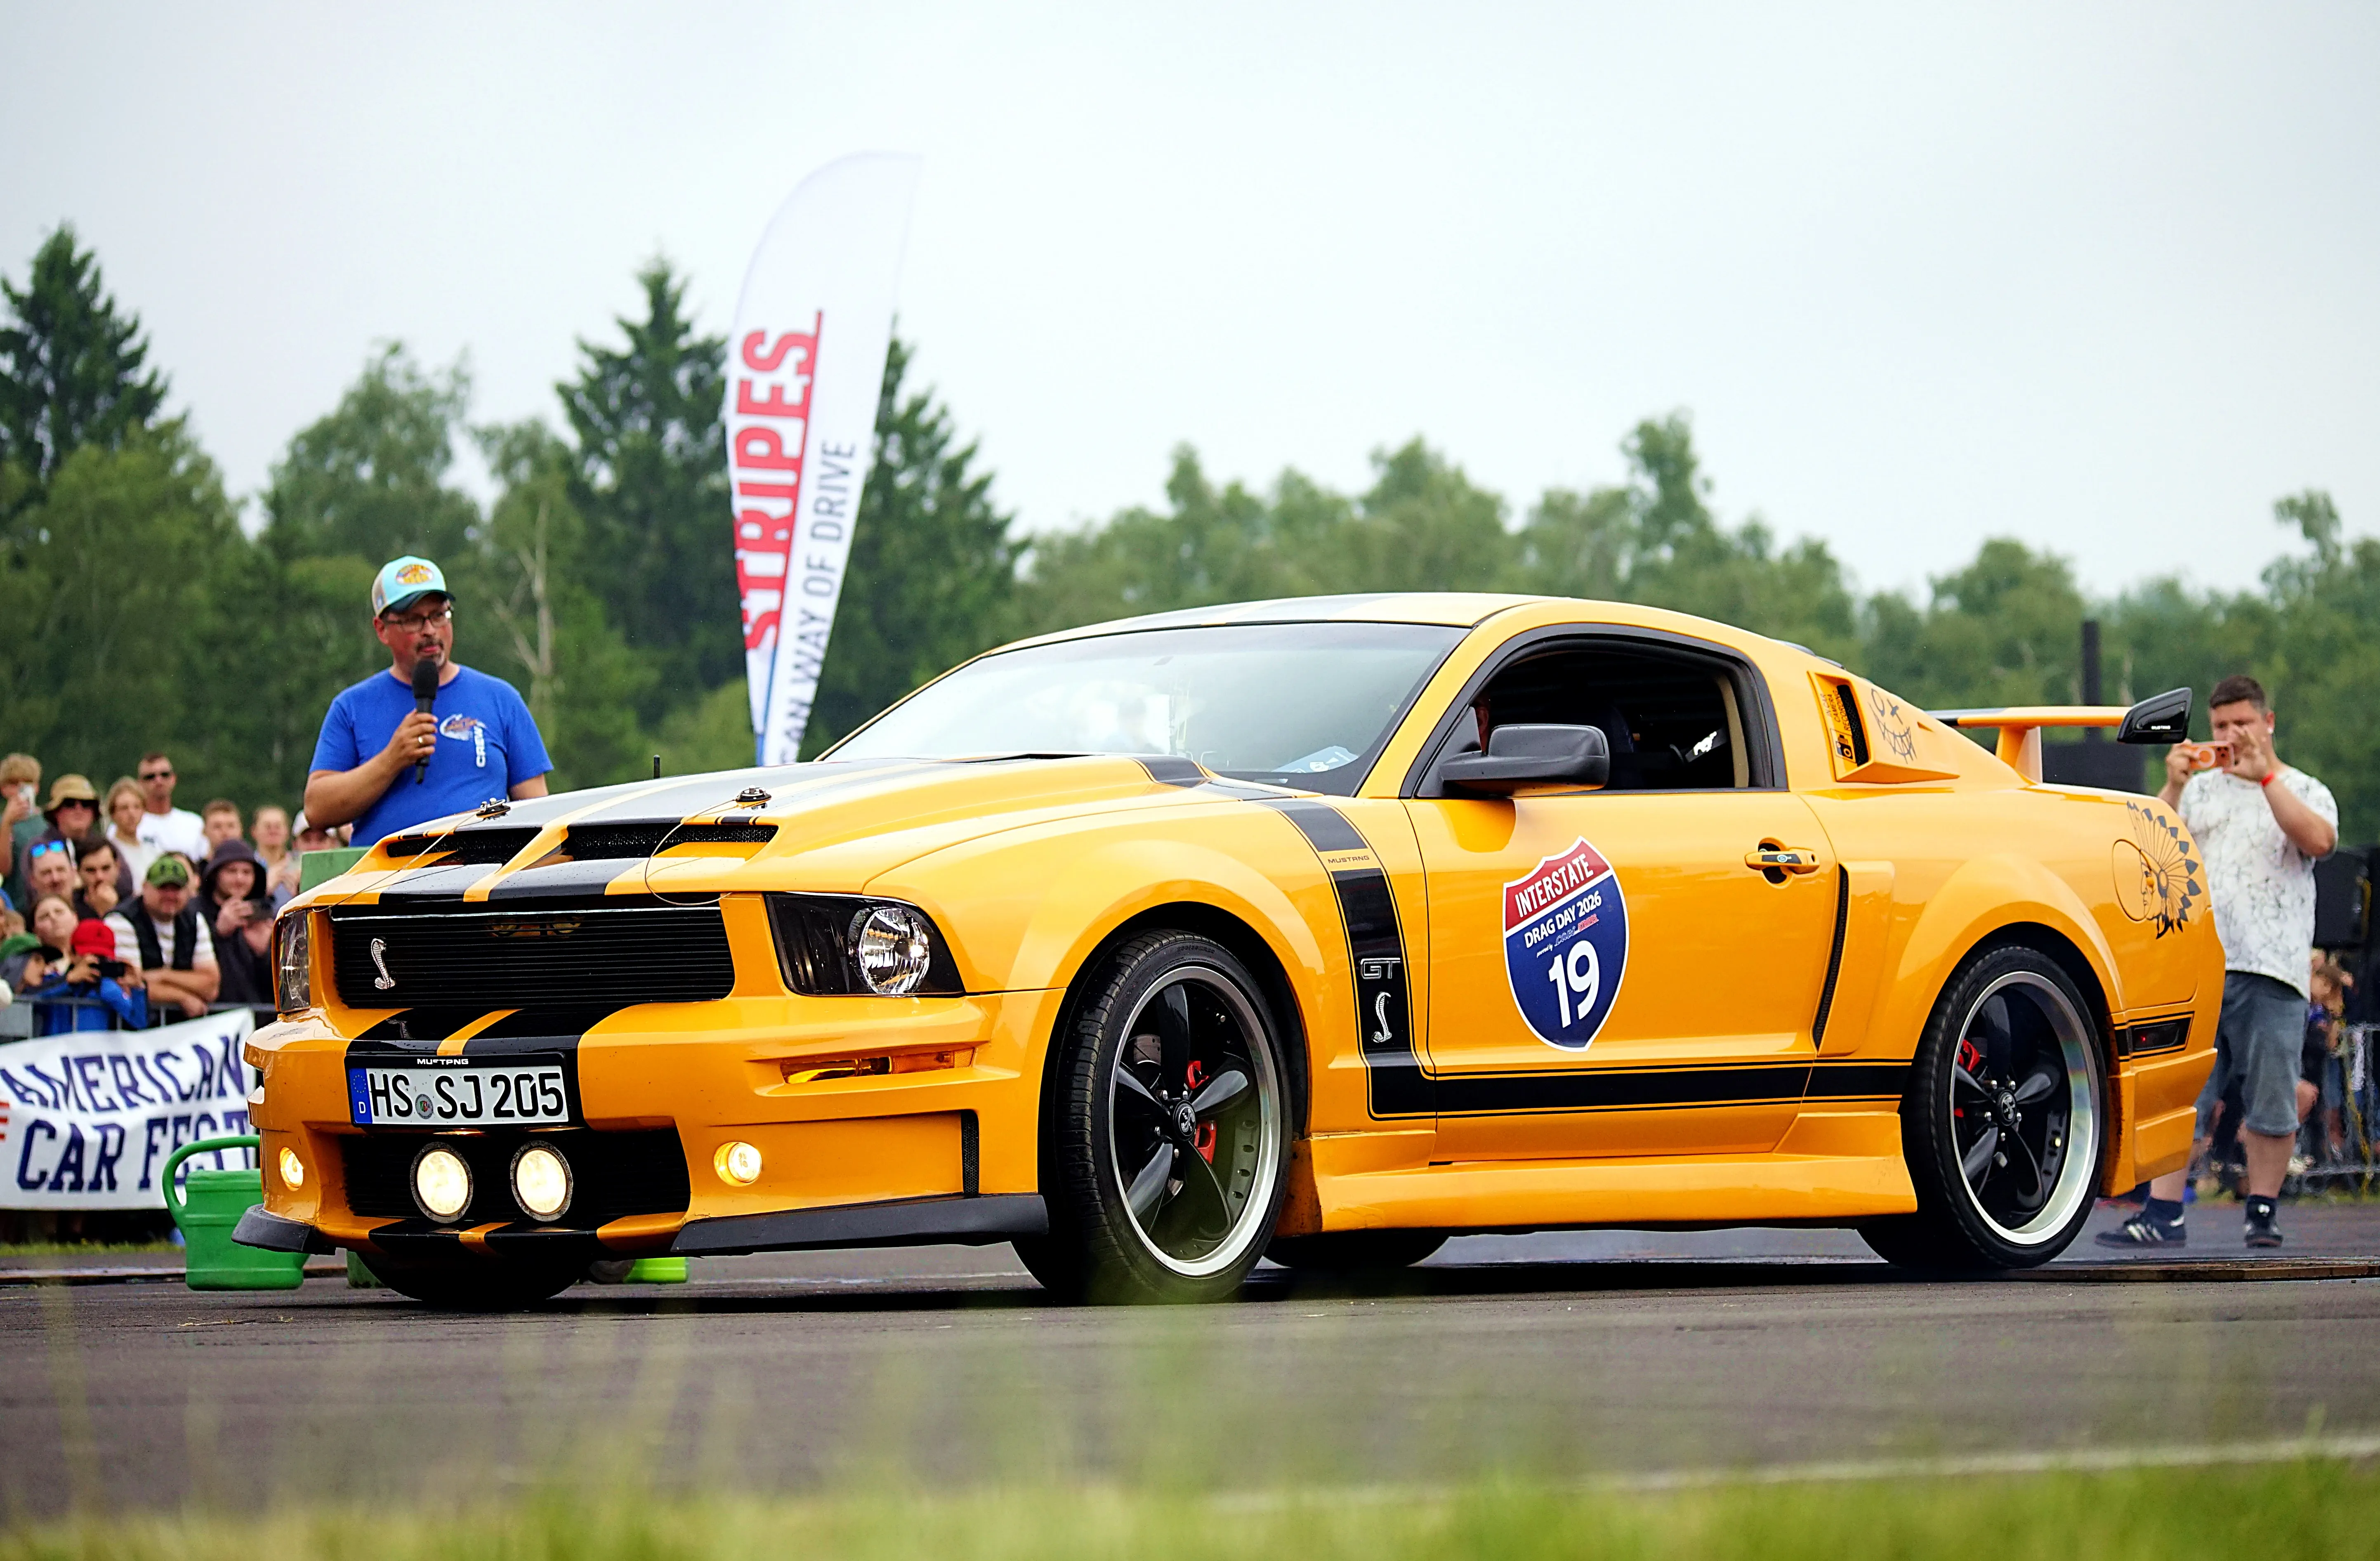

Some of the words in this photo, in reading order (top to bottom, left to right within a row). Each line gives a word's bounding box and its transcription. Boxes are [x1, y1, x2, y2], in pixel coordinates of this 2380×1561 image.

[809, 439, 856, 541] DRIVE
[802, 555, 836, 597] OF
[790, 606, 828, 684] WAY
[1820, 693, 1830, 708] CAR
[1827, 694, 1841, 723] CAMERA
[1833, 690, 1852, 731] RECORDING
[474, 726, 486, 768] CREW
[1327, 855, 1370, 864] MUSTANG
[1514, 853, 1594, 918] INTERSTATE
[1524, 918, 1556, 948] DRAG
[1555, 905, 1576, 929] DAY
[1576, 890, 1602, 917] 2026
[1360, 957, 1401, 980] GT
[1548, 940, 1599, 1028] 19
[0, 1033, 245, 1113] AMERICAN
[359, 1101, 366, 1114] D
[369, 1073, 413, 1117] HS
[435, 1075, 483, 1119] SJ
[491, 1072, 564, 1117] 205
[16, 1119, 125, 1192] CAR
